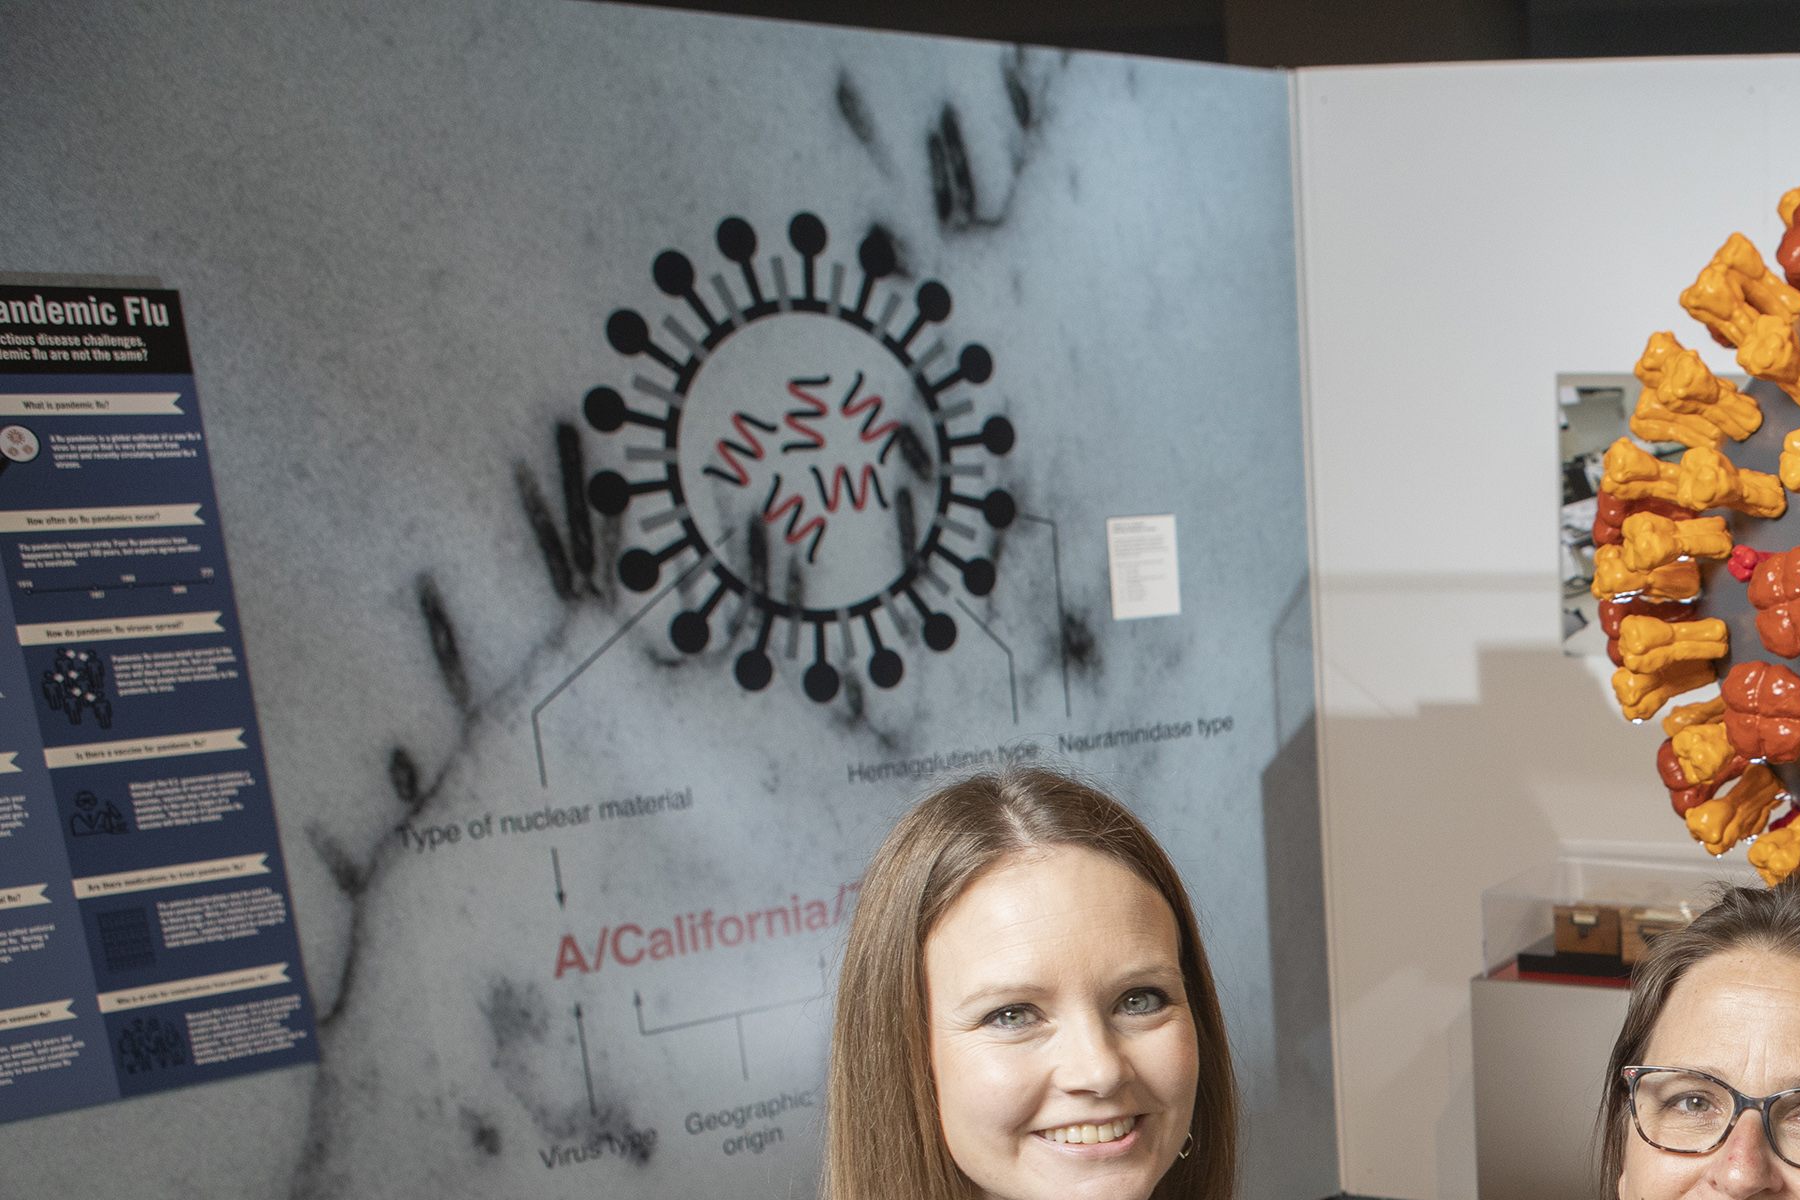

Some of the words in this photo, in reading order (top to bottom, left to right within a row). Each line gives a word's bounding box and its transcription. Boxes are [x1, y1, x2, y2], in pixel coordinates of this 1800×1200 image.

[123, 295, 170, 327] Flu
[31, 347, 48, 361] flu
[49, 350, 70, 361] are
[70, 349, 91, 361] not
[91, 348, 112, 361] the
[112, 348, 148, 362] same?
[36, 332, 82, 347] disease
[82, 333, 147, 349] challenges.
[22, 400, 45, 411] What
[46, 400, 54, 410] is
[55, 400, 95, 412] pandemic
[95, 400, 110, 410] flu?
[27, 517, 44, 526] How
[46, 516, 67, 526] often
[68, 516, 79, 524] do
[79, 515, 91, 524] flu
[92, 514, 134, 525] pandemics
[1058, 718, 1193, 753] Neuraminidase
[1197, 715, 1234, 736] type
[998, 741, 1039, 763] type
[393, 823, 461, 854] Type
[467, 811, 493, 840] of
[500, 804, 593, 835] nuclear
[598, 785, 694, 821] material
[684, 1087, 813, 1136] Geographic
[538, 1140, 601, 1169] Virus
[602, 1126, 658, 1162] type
[722, 1123, 785, 1157] origin
